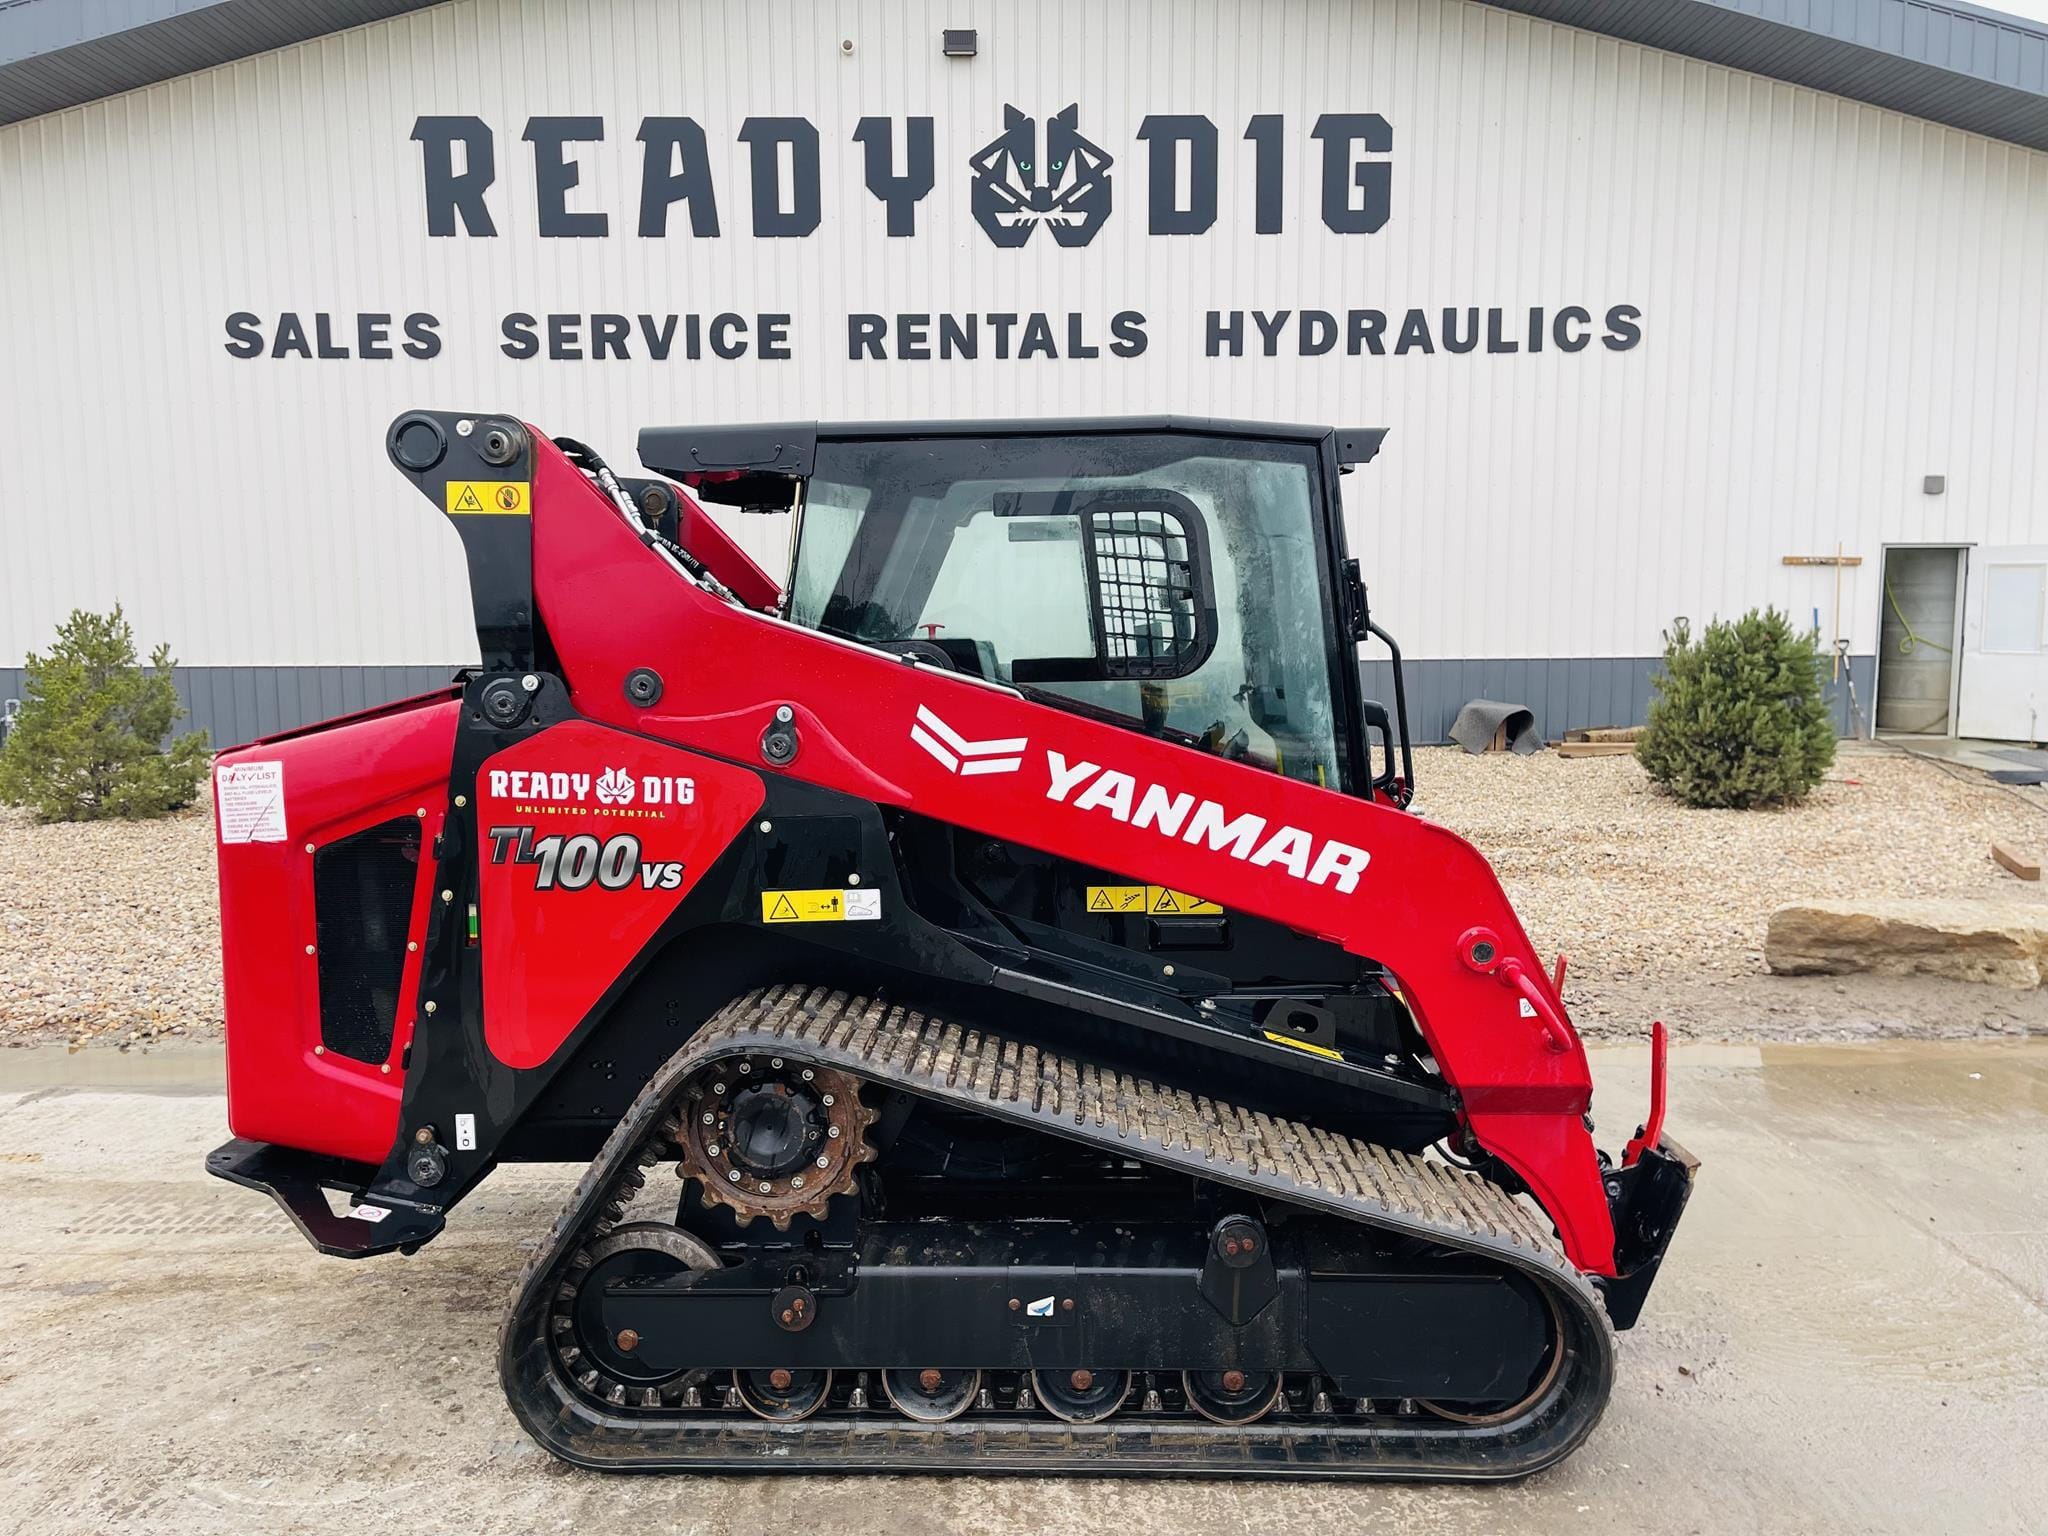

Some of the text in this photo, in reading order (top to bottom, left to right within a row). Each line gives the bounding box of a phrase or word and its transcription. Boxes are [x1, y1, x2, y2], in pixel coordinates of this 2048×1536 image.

[410, 114, 1393, 238] READY DIG
[225, 304, 1642, 361] SALES SERVICE RENTALS HYDRAULICS
[256, 771, 276, 780] LIST
[489, 770, 695, 805] READY DIG
[515, 804, 666, 819] UNLIMITED POTENTIAL
[1046, 749, 1371, 894] YANMAR
